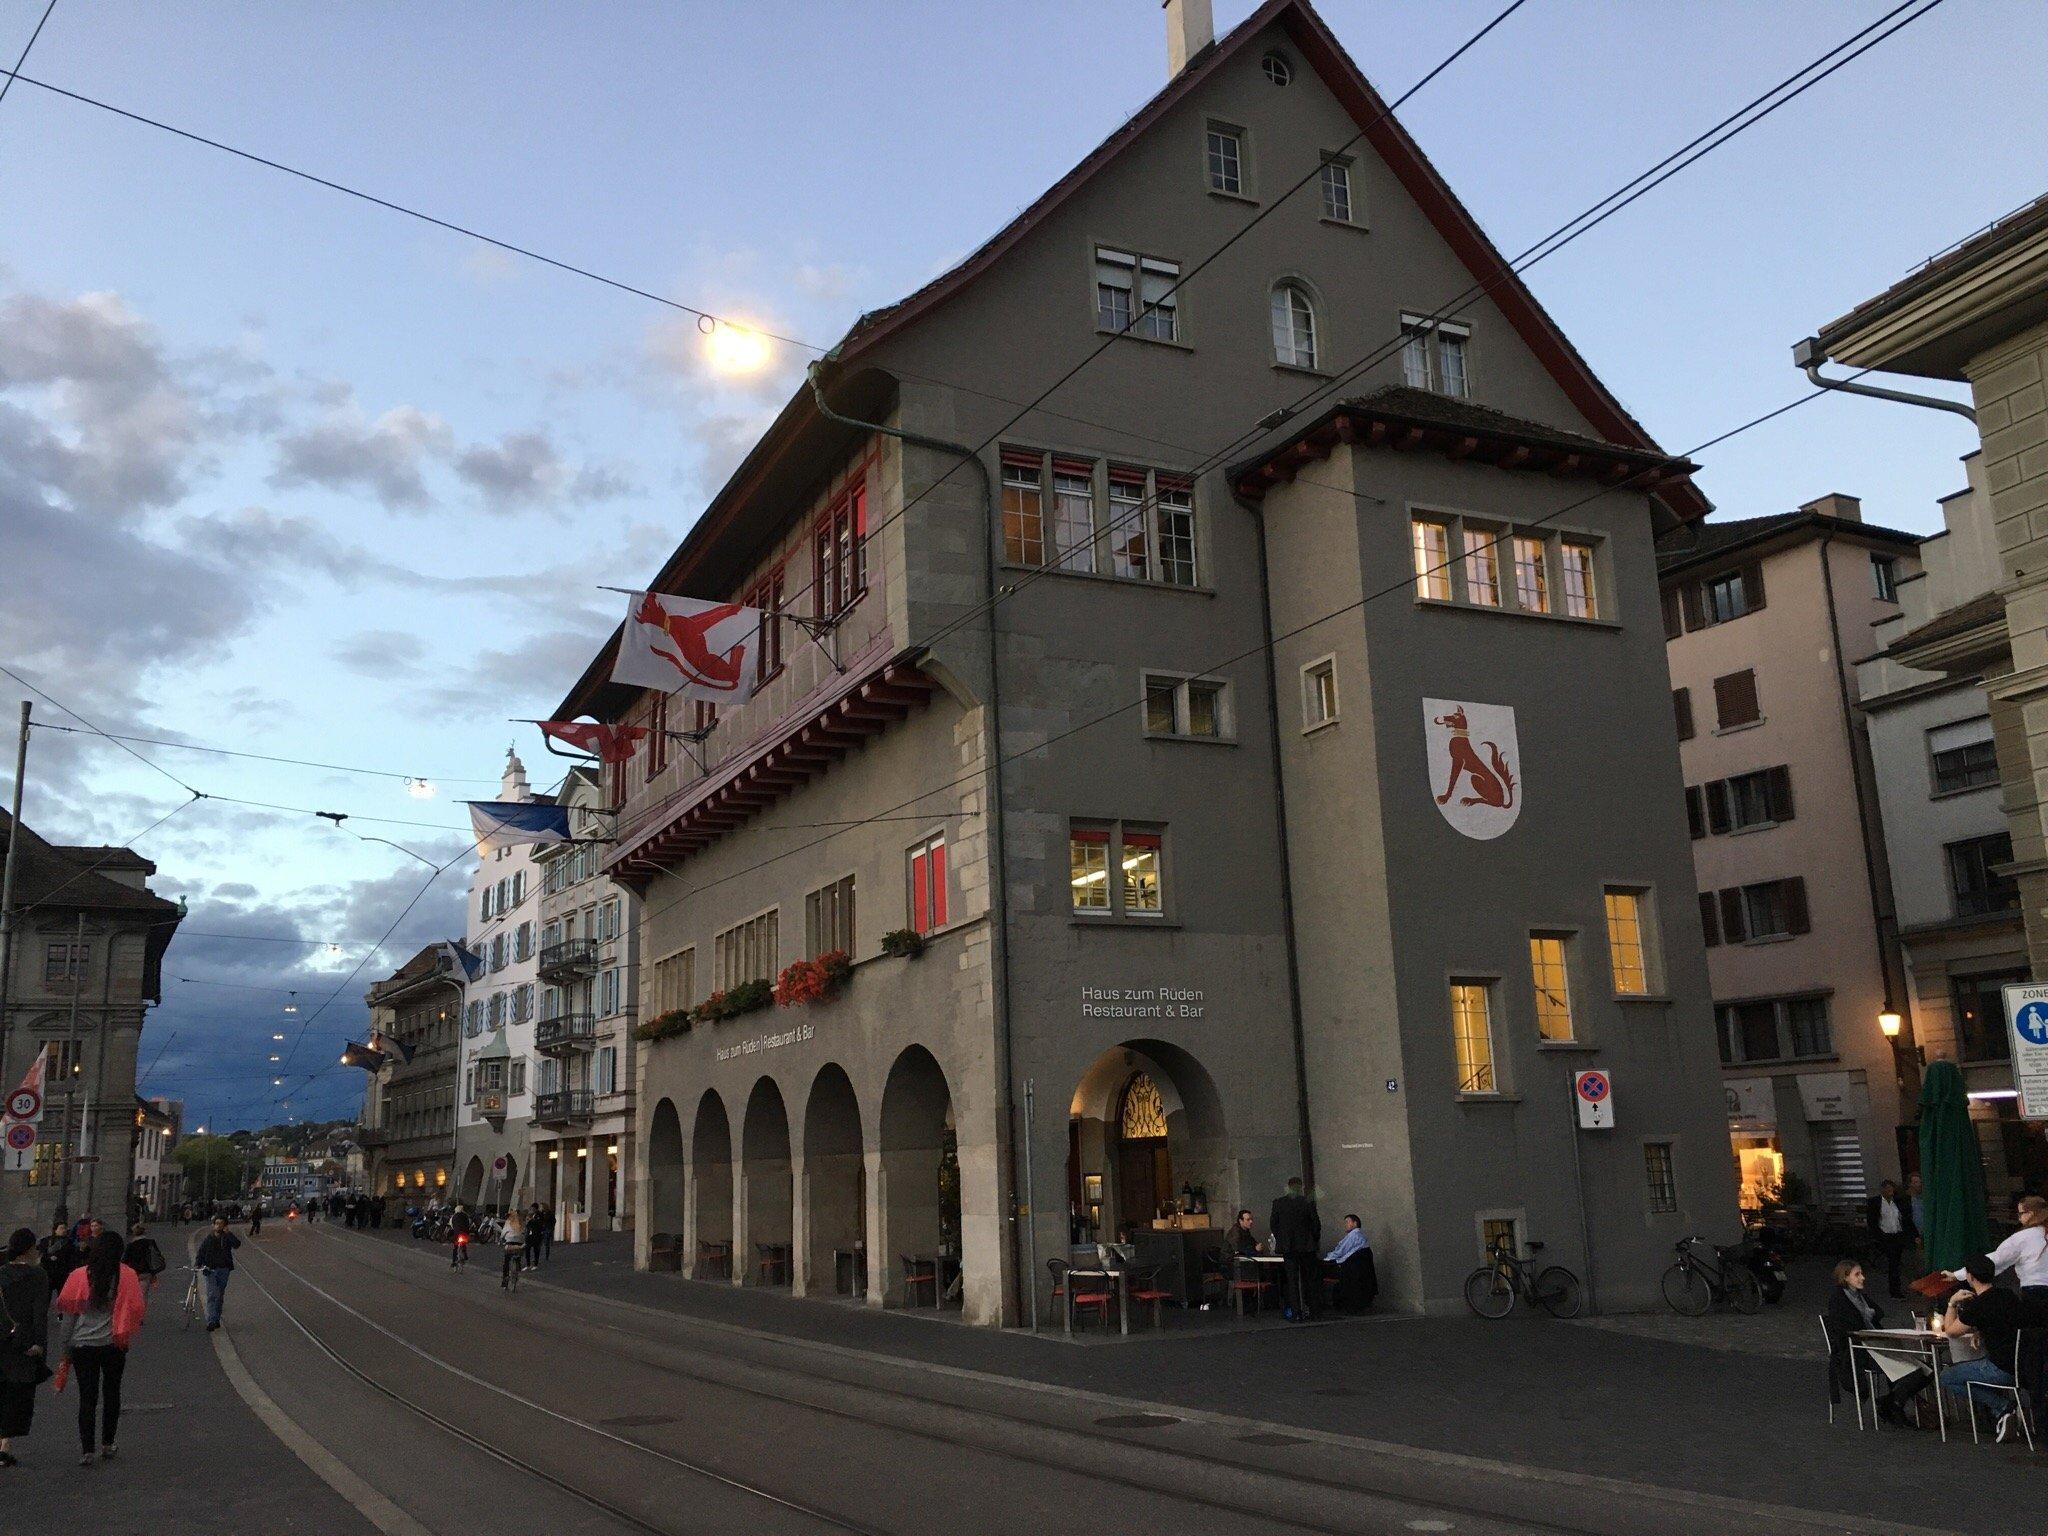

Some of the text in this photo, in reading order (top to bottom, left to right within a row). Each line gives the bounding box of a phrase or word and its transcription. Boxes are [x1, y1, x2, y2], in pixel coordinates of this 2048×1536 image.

[1081, 986, 1203, 1001] Haus zum Rüden
[2022, 989, 2048, 999] ZONE
[1082, 1003, 1204, 1018] Restaurant & Bar
[716, 1024, 815, 1061] Haus zum Rüden Restaurant & Bar
[17, 1098, 31, 1110] 30
